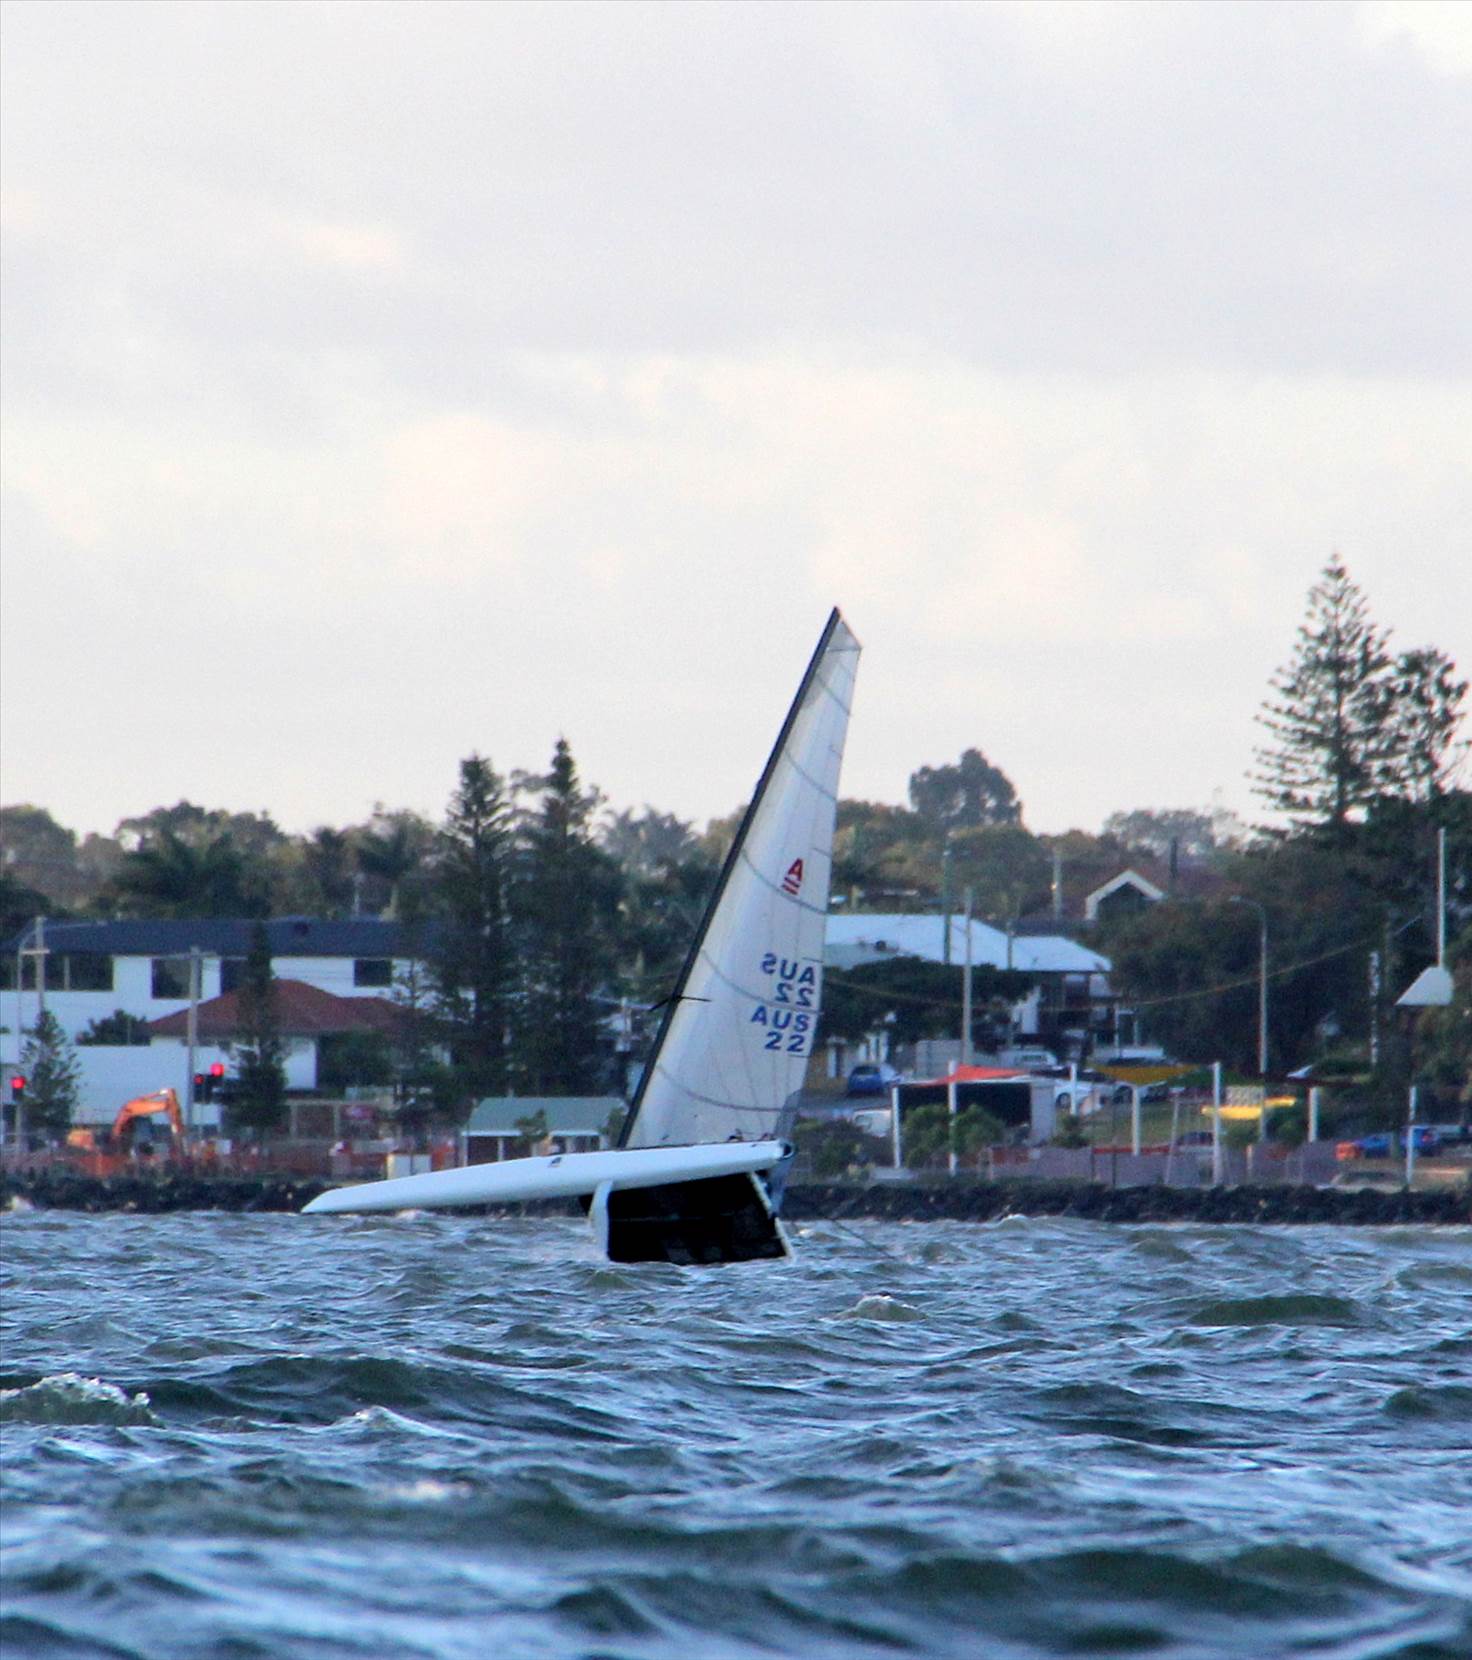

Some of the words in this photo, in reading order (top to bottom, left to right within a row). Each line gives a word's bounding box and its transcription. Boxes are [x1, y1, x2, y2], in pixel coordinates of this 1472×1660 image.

[788, 858, 803, 882] A
[751, 1005, 809, 1032] AUS
[764, 1032, 805, 1053] 22
